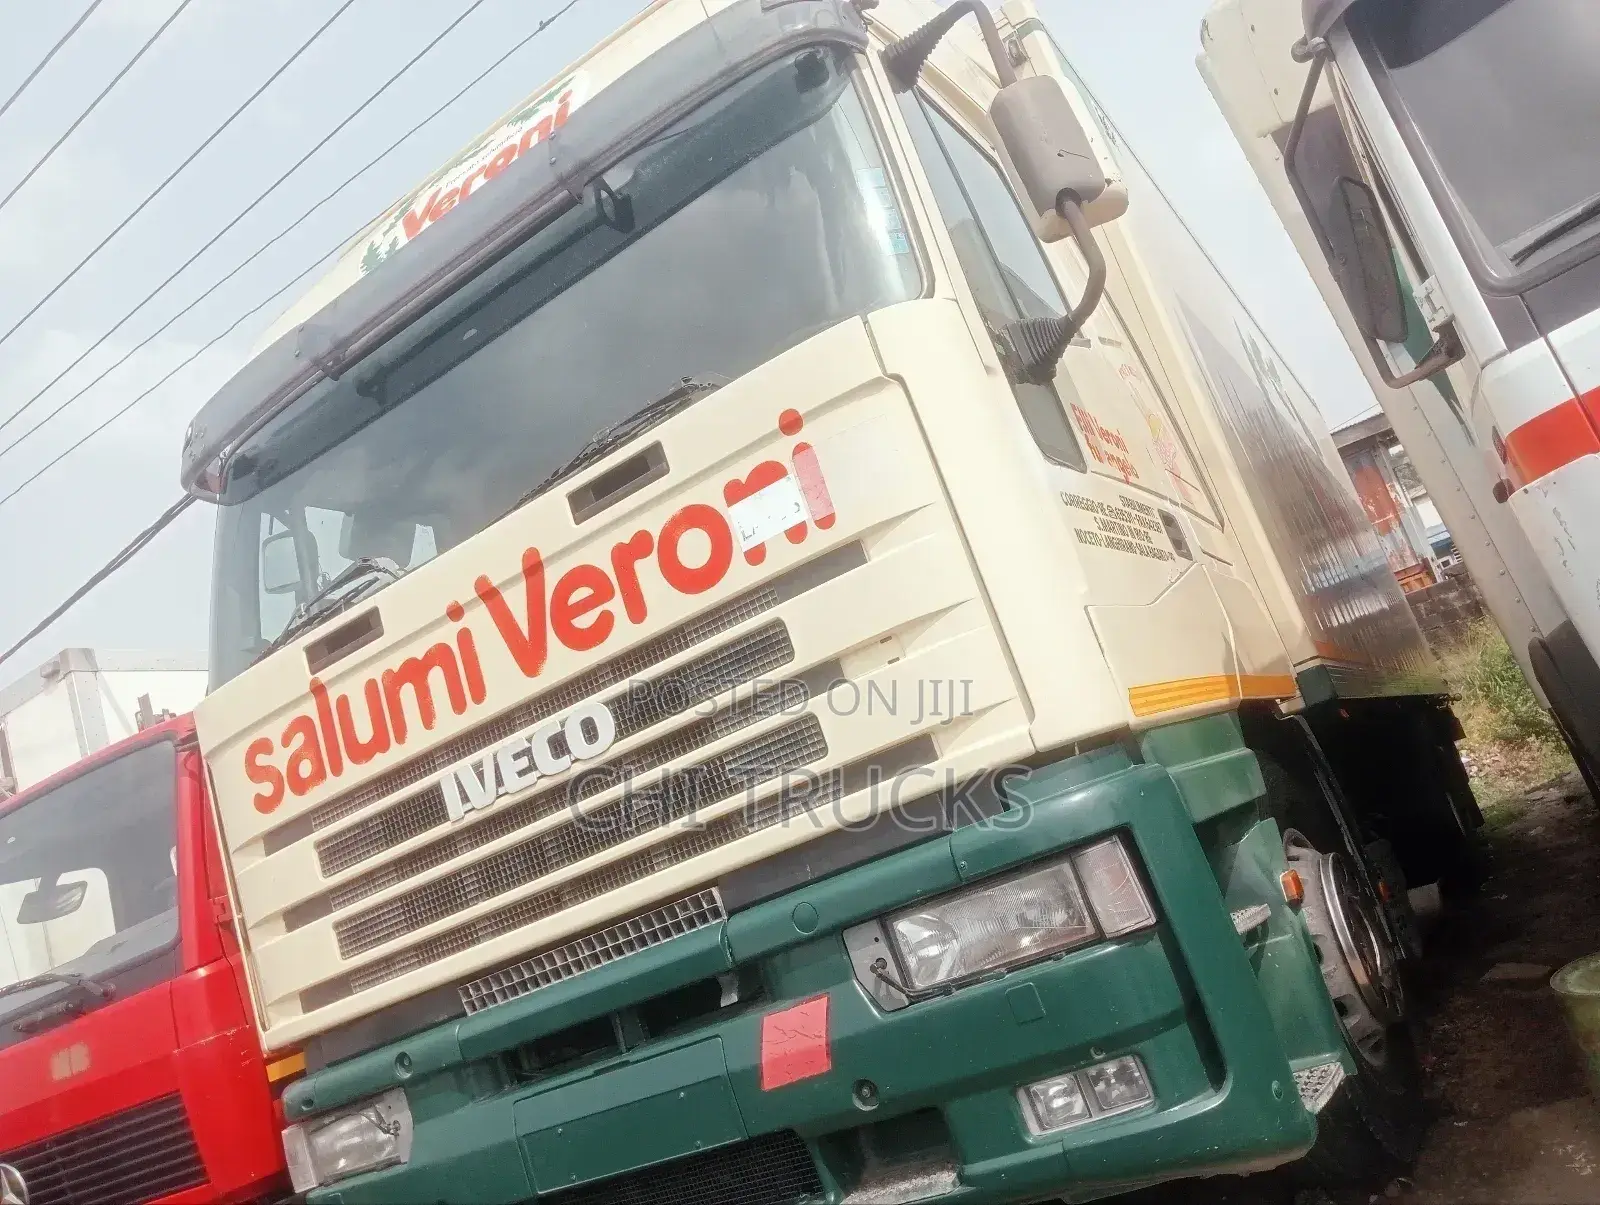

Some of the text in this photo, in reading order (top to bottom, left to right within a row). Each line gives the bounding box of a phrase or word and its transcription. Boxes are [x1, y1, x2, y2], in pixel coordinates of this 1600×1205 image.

[402, 89, 574, 241] Veroni
[1087, 412, 1129, 454] Veroni
[244, 408, 836, 815] salumi Veroni
[440, 701, 616, 823] IVECO
